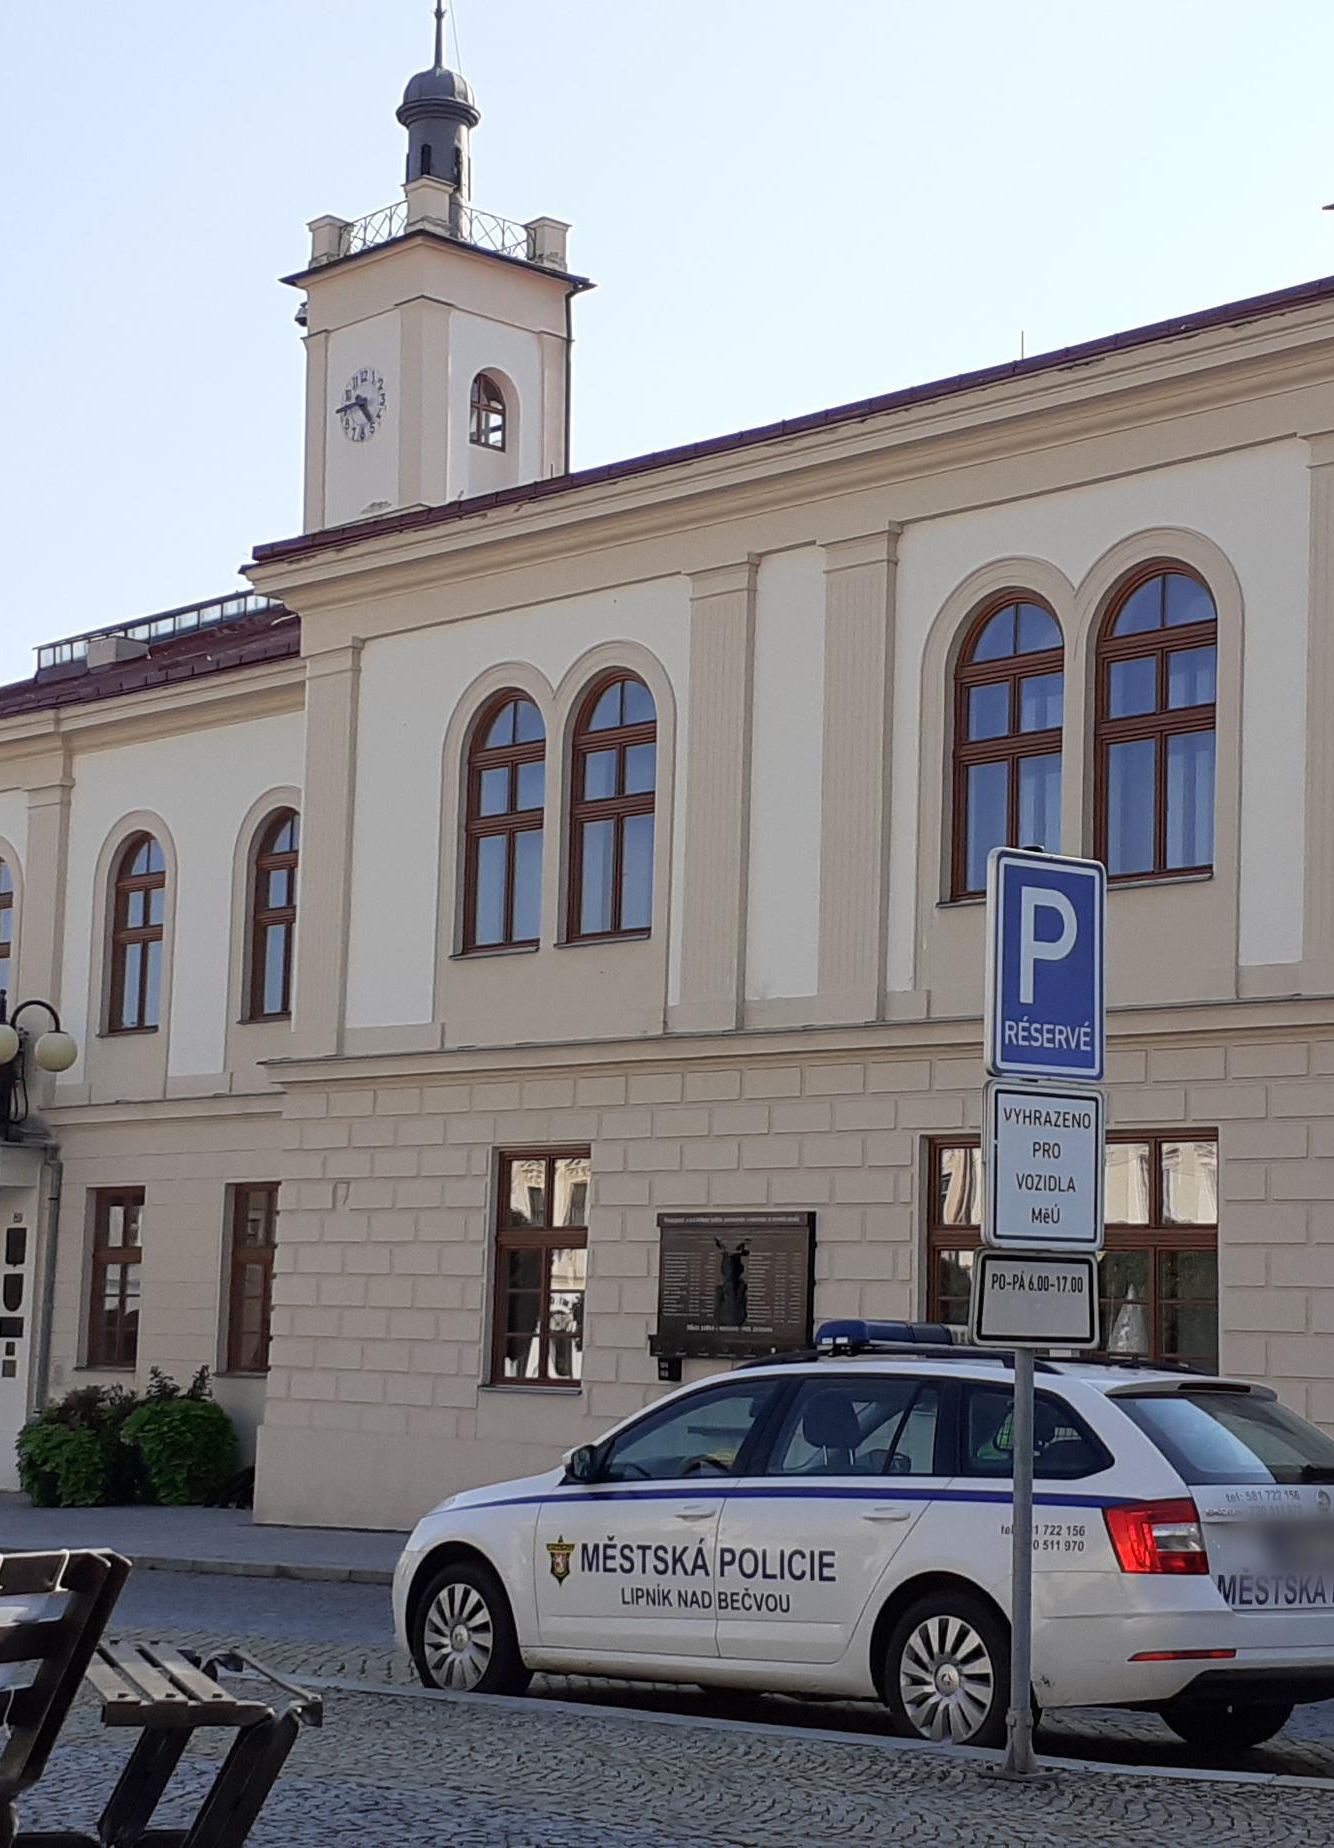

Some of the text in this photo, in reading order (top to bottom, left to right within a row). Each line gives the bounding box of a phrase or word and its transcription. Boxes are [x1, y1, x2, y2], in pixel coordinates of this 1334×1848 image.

[1019, 886, 1078, 1004] P
[1004, 1015, 1092, 1051] RÉSERVÉ
[1003, 1107, 1092, 1130] VYHRAZENO
[1032, 1141, 1062, 1160] PRO
[1016, 1173, 1076, 1193] VOZIDLA
[1031, 1203, 1061, 1224] MěÚ
[991, 1270, 1084, 1294] PO-PÁ 6.00-17.00
[1245, 1490, 1264, 1502] 581
[1264, 1489, 1282, 1501] 722
[1043, 1525, 1063, 1536] 722
[1066, 1525, 1085, 1537] 156
[1042, 1540, 1061, 1551] 511
[1064, 1540, 1085, 1552] 970
[581, 1535, 837, 1582] MĚSTSKÁ POLICIE
[621, 1583, 791, 1613] LIPNÍK NAD BEČVOU
